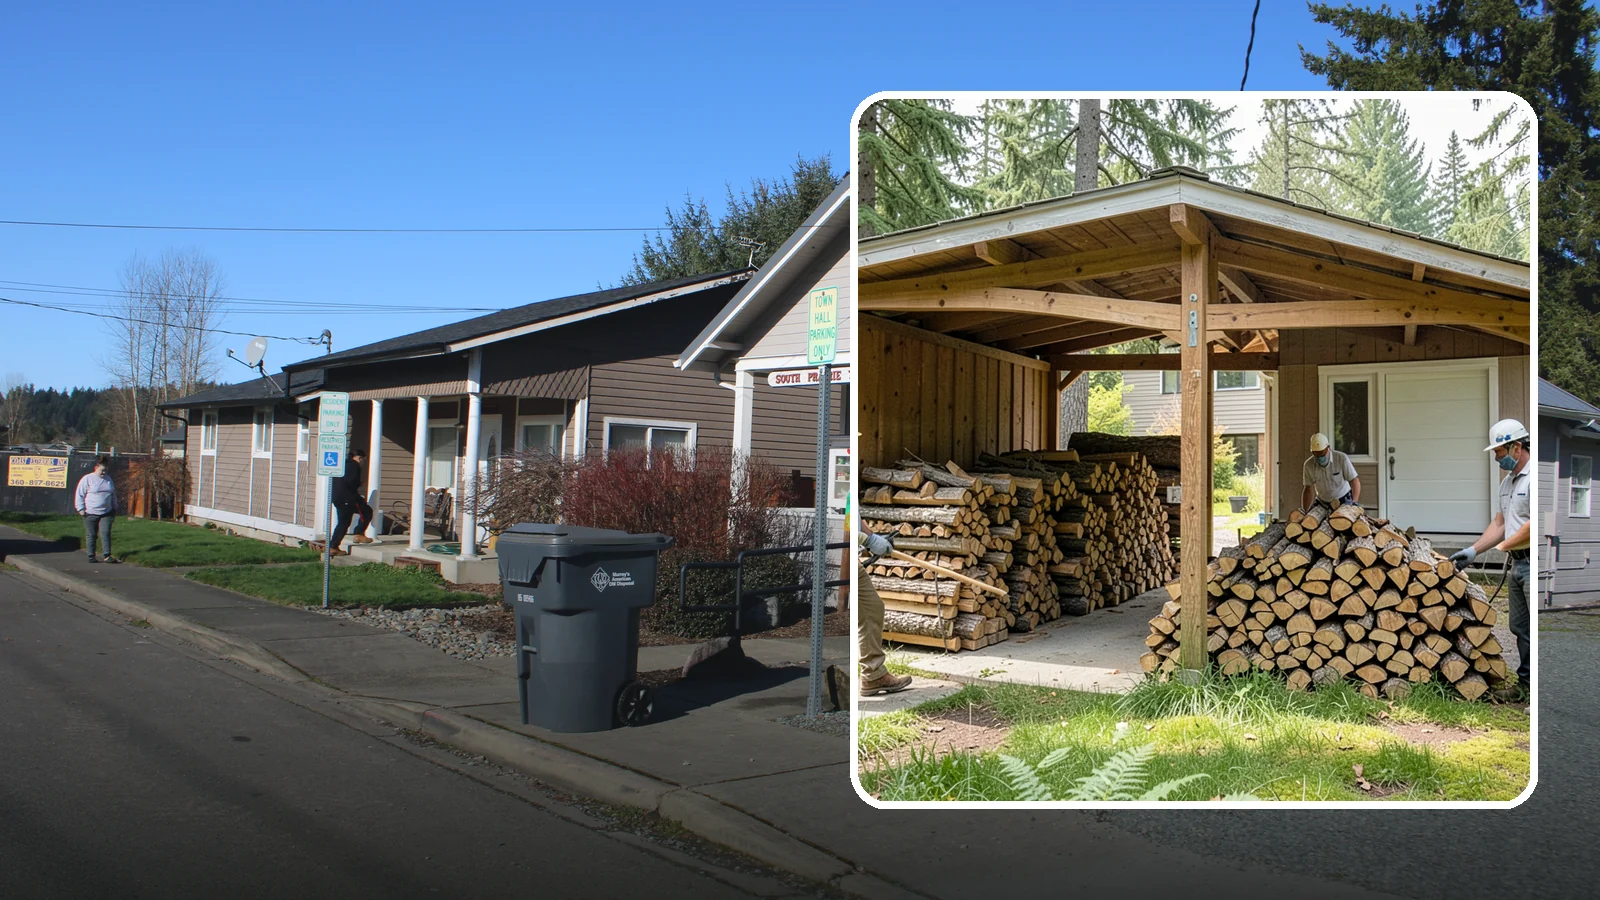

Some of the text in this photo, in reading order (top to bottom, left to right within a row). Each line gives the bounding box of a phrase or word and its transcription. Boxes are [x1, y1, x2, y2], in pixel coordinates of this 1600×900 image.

[815, 295, 833, 308] TOWN
[815, 311, 831, 324] HALL
[810, 327, 836, 340] PARKING
[813, 344, 831, 357] ONLY
[775, 373, 801, 384] SOUTH
[807, 370, 842, 382] PRIE
[10, 479, 65, 487] 360-897-8625
